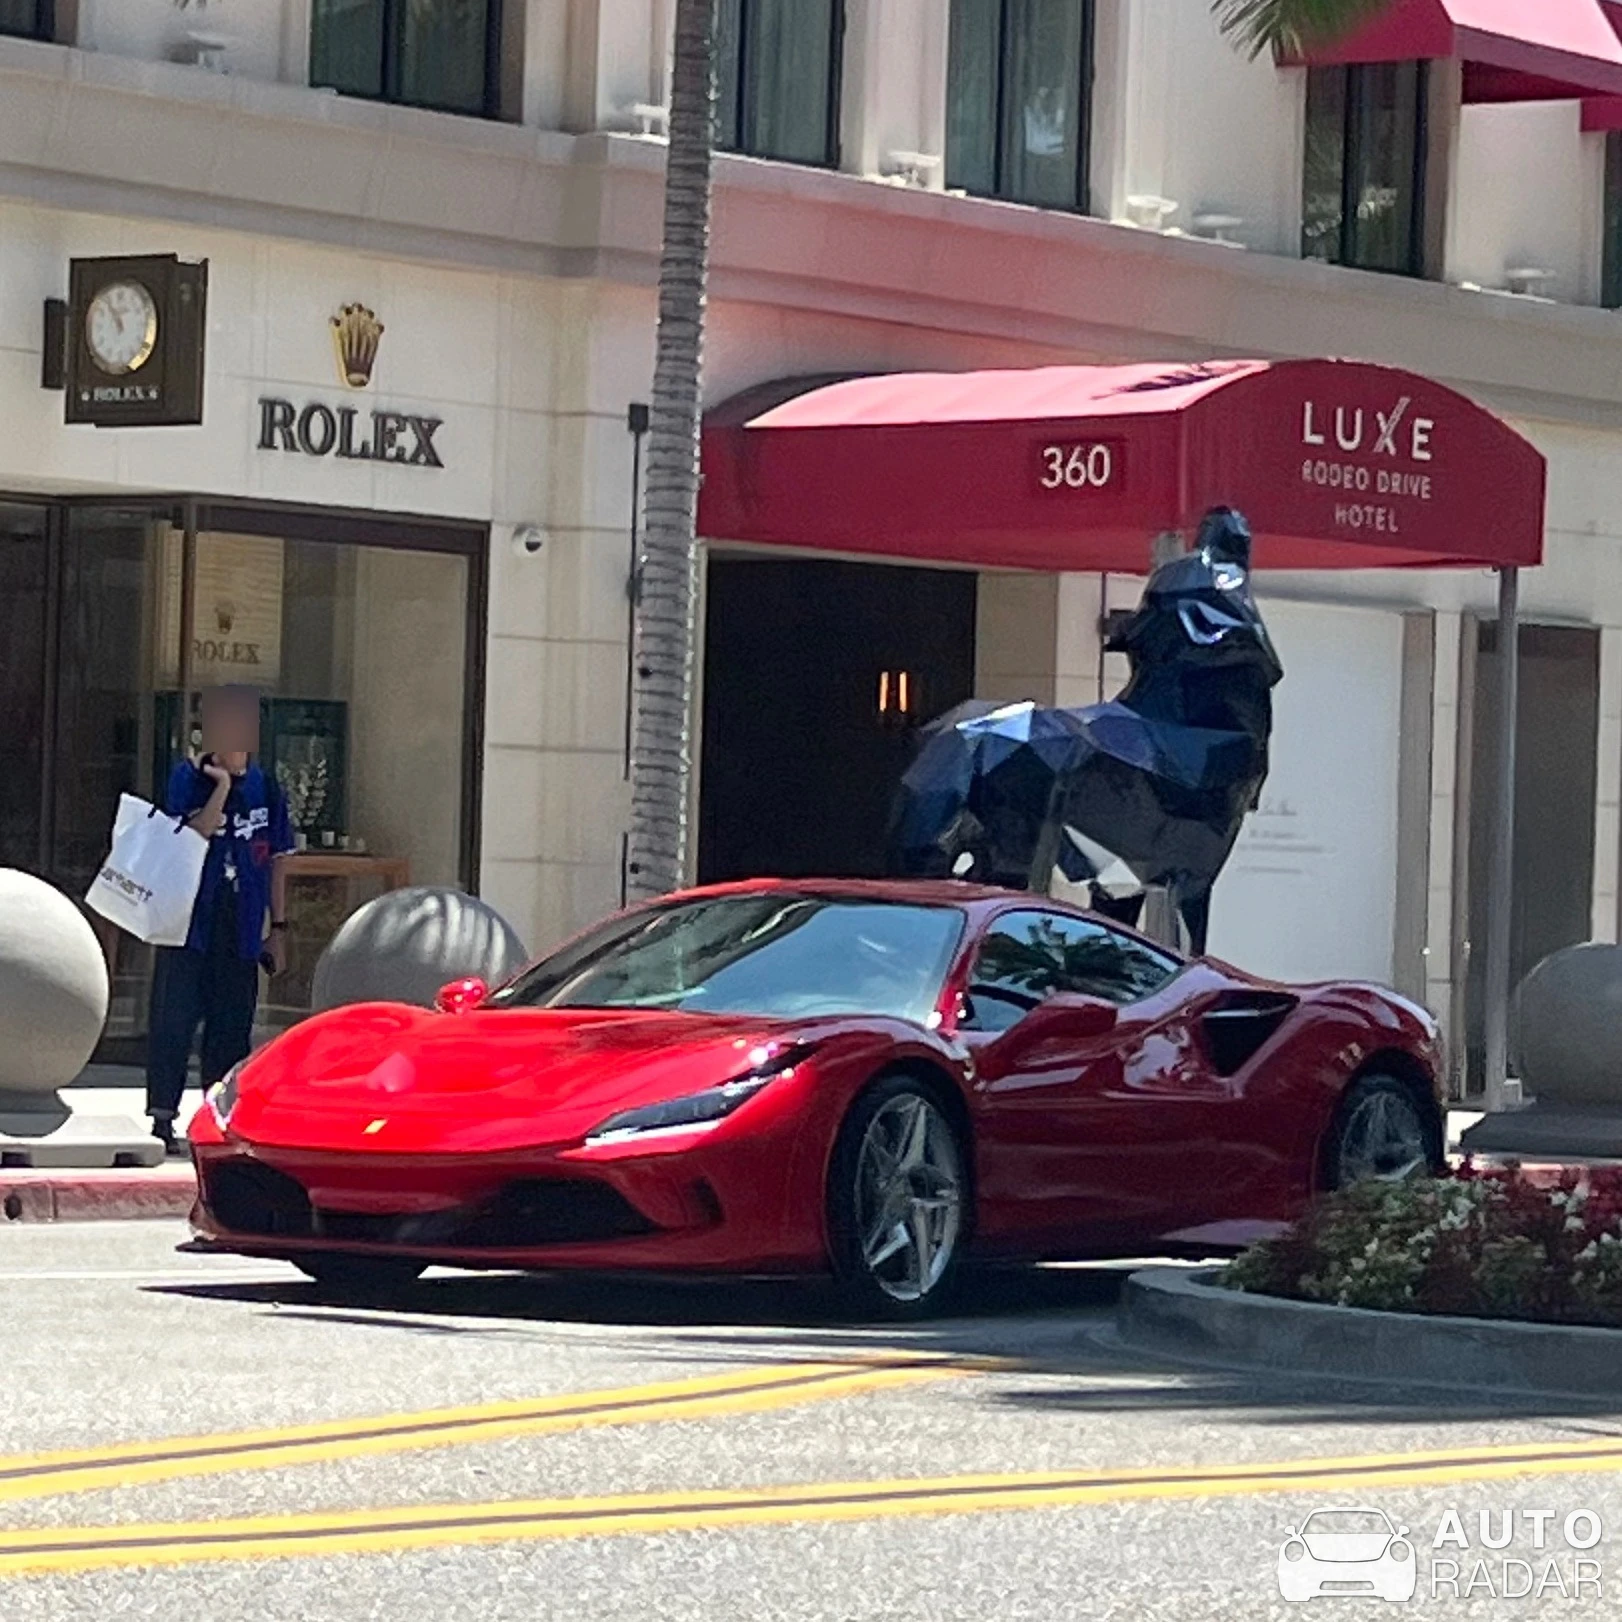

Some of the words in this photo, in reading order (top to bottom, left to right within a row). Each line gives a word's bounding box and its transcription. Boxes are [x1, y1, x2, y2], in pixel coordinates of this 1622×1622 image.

[256, 395, 444, 469] ROLEX
[1302, 397, 1434, 461] LUXE
[1040, 444, 1111, 489] 360
[1302, 459, 1368, 492] RODEO
[1377, 468, 1432, 499] DRIVE
[1335, 503, 1399, 533] HOTEL
